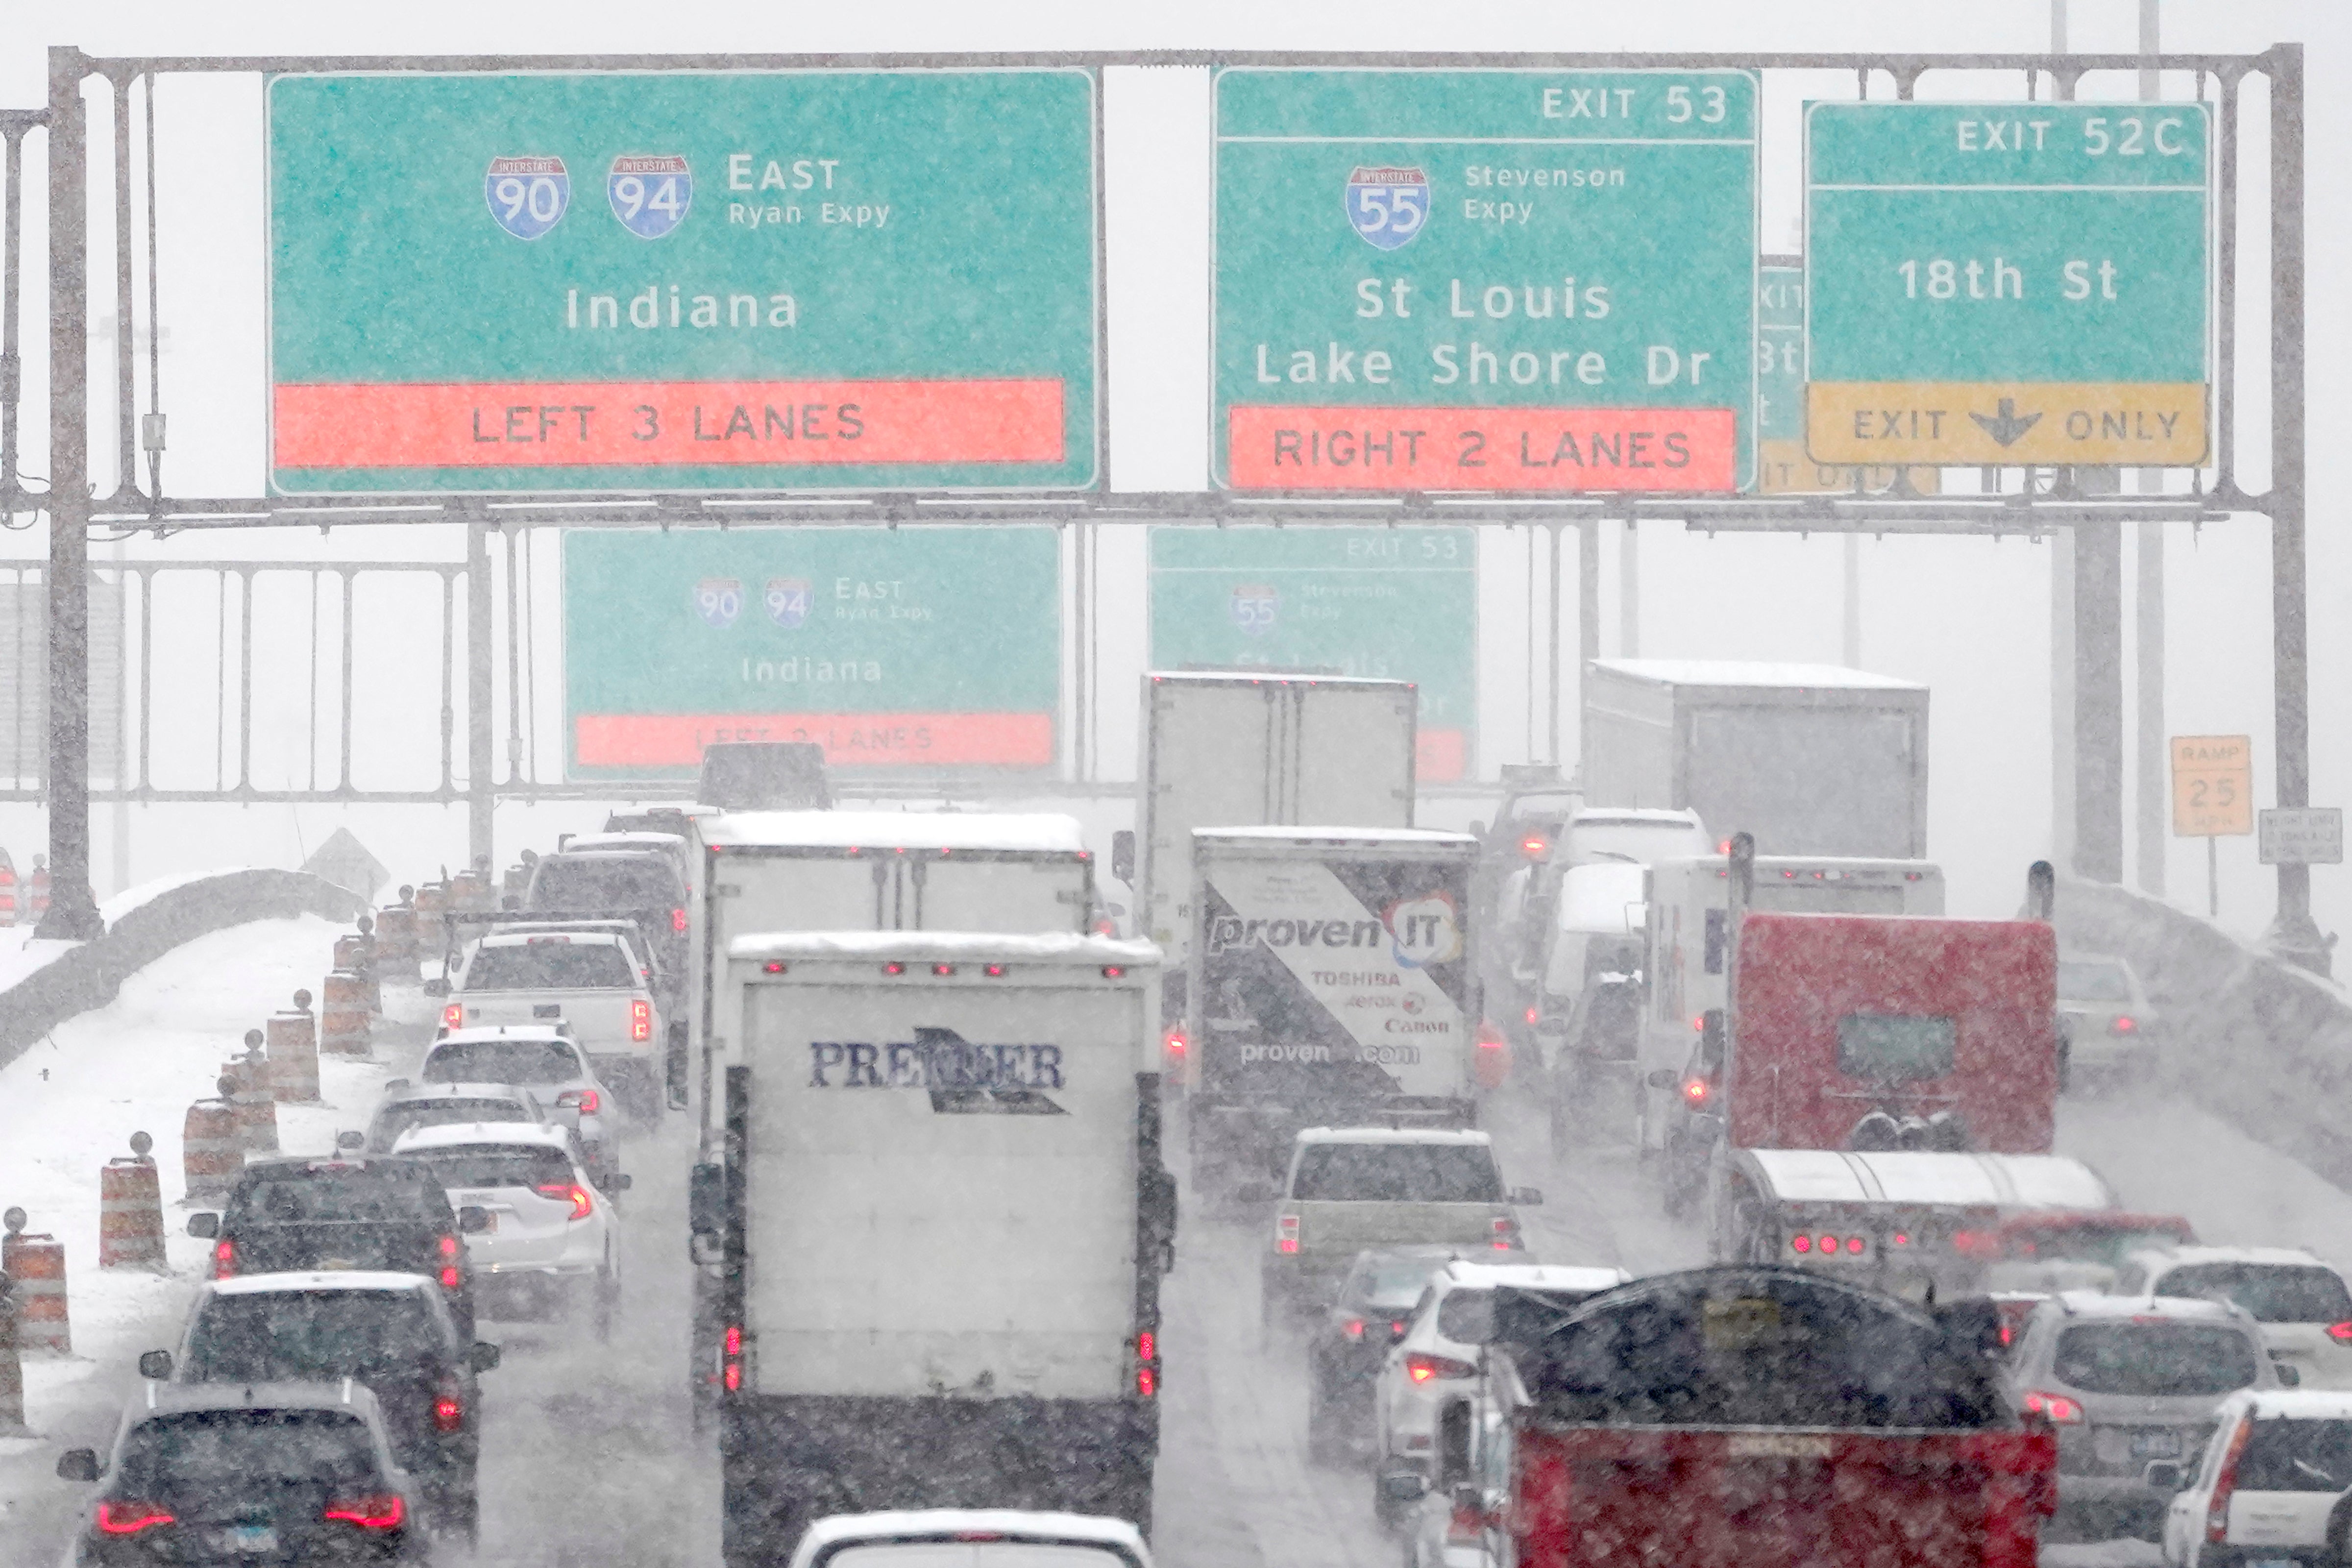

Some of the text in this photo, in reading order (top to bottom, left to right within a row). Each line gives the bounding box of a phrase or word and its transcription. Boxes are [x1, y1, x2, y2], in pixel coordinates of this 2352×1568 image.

[1543, 86, 1727, 122] EXIT 53
[1958, 118, 2183, 156] EXIT 52C
[499, 161, 554, 173] INTERSTATE
[622, 161, 677, 172] INTERSTATE
[729, 153, 838, 191] EAST
[1360, 171, 1414, 183] INTERSTATE
[1465, 165, 1626, 188] Stevenson
[495, 177, 559, 222] 90
[615, 177, 680, 221] 94
[1359, 188, 1421, 233] 55
[1464, 198, 1534, 226] Expy
[729, 200, 890, 229] Ryan Expy
[1898, 257, 2118, 300] 18th St
[567, 284, 799, 329] Indiana
[1356, 277, 1611, 319] St Louis
[1760, 284, 1802, 308] XIT
[1256, 342, 1710, 385] Lake Shore Dr
[471, 403, 866, 444] LEFT 3 LANES
[1854, 410, 2181, 441] EXIT ONLY
[1274, 430, 1691, 468] RIGHT 2 LANES
[1347, 535, 1459, 559] EXIT 53
[835, 577, 903, 600] EAST
[700, 591, 739, 618] 90
[767, 591, 807, 618] 94
[835, 605, 879, 620] Ryan
[1237, 599, 1275, 626] 55
[742, 656, 883, 682] Indiana
[828, 727, 932, 750] LANES
[2181, 746, 2239, 760] RAMP
[2189, 778, 2235, 808] 25
[1208, 914, 1445, 956] proven IT
[1312, 970, 1400, 987] TOSHIBA
